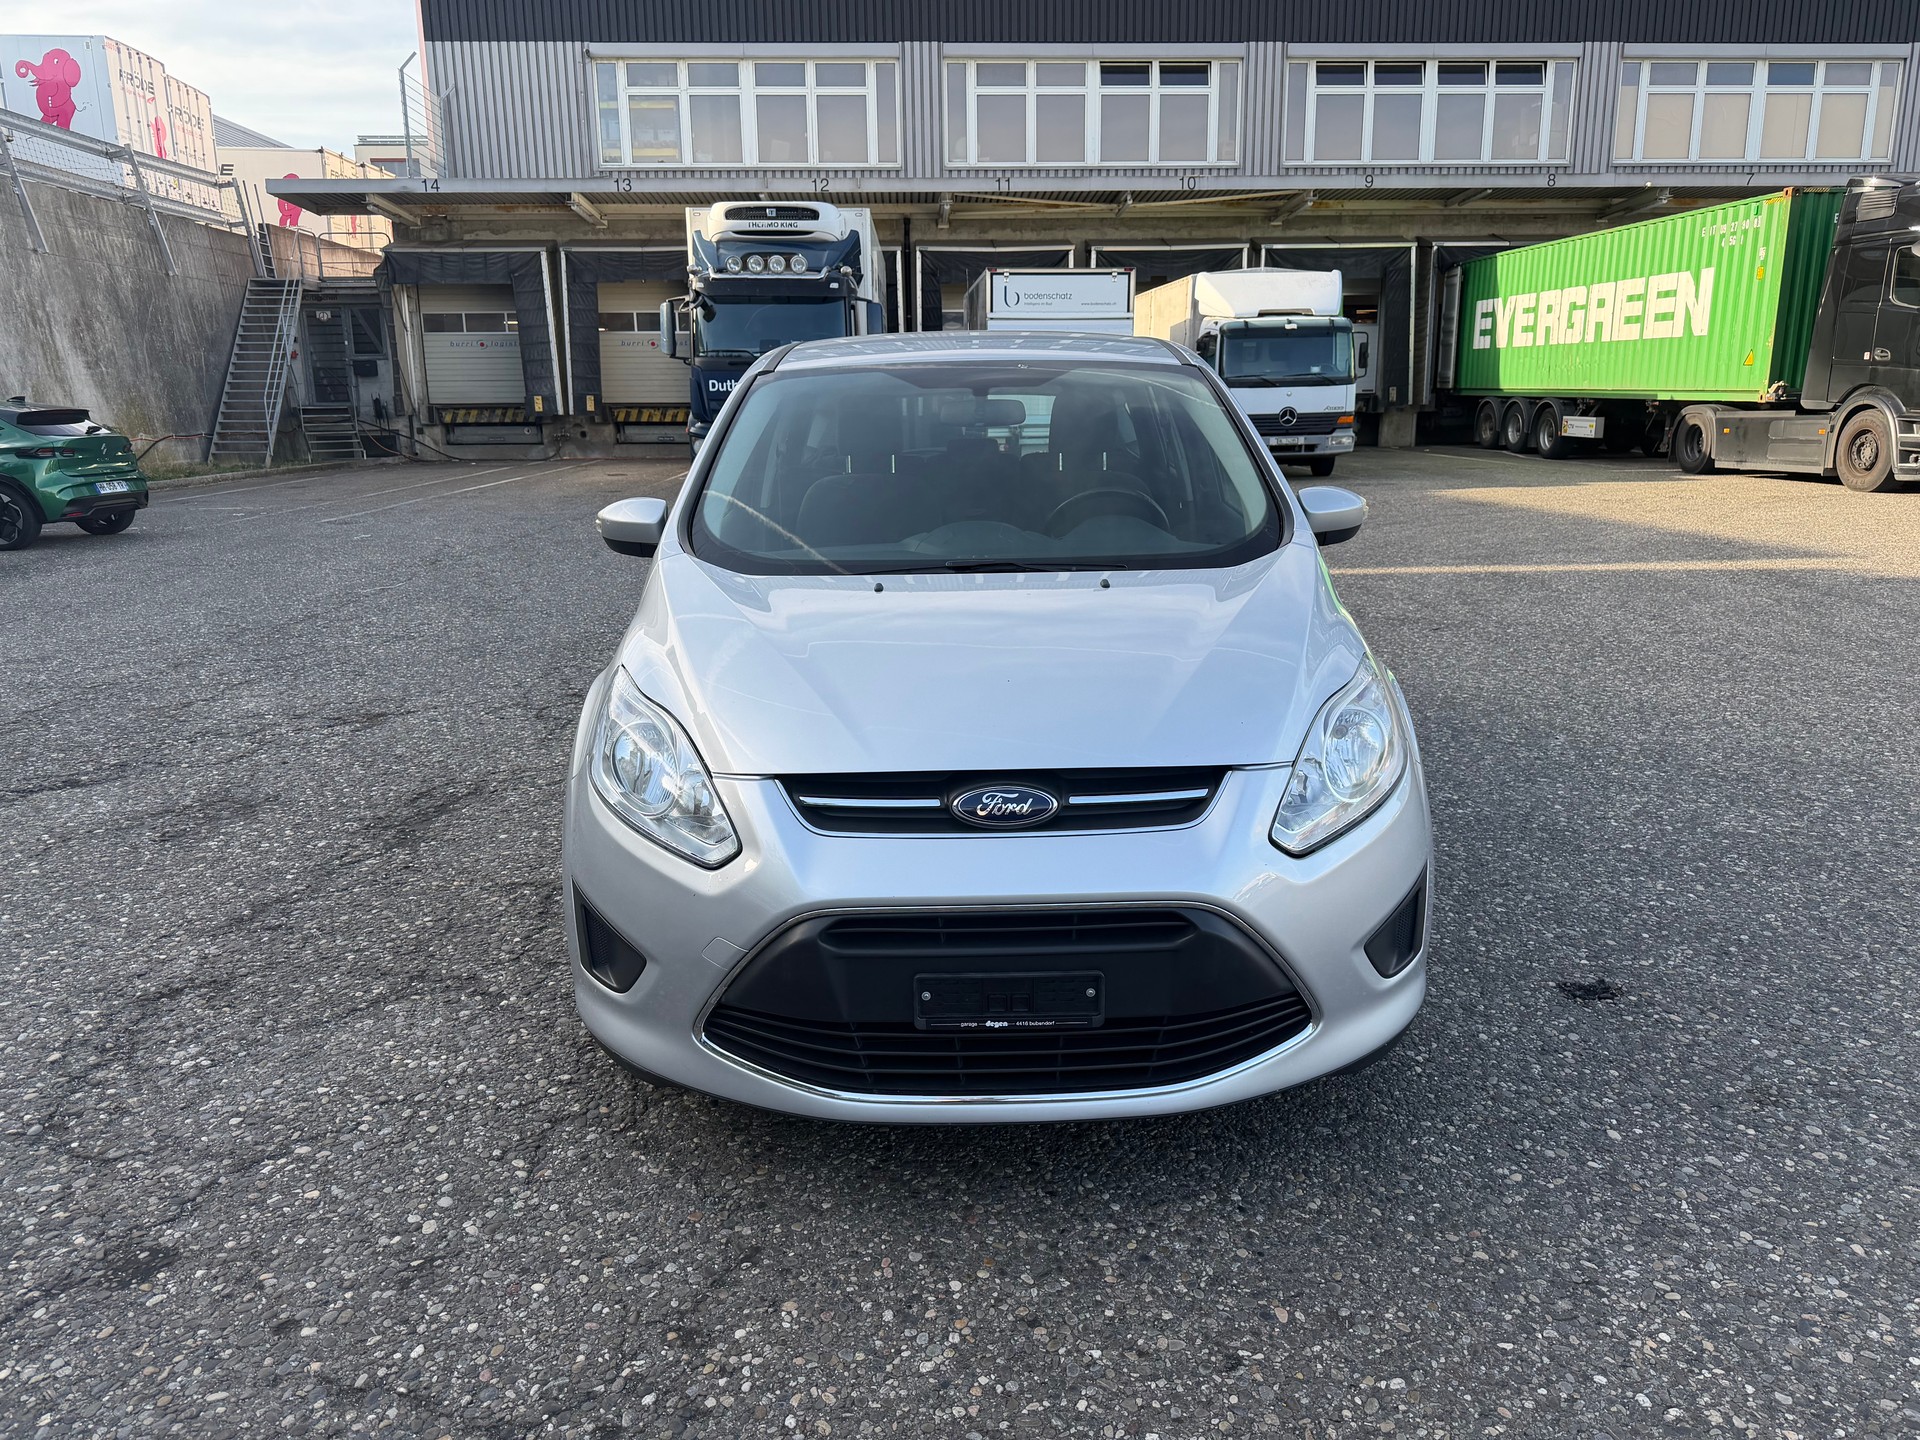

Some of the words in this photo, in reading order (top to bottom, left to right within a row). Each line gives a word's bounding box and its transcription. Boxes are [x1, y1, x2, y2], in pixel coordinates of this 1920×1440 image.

[421, 178, 440, 192] 14
[613, 177, 632, 192] 13
[811, 178, 830, 191] 12
[995, 178, 1010, 191] 11
[1179, 176, 1196, 190] 10
[1364, 174, 1374, 188] 9
[1547, 173, 1556, 187] 8
[1746, 172, 1755, 185] 7
[1023, 292, 1073, 300] bodenschatz
[1472, 267, 1715, 350] EVERGREEN
[976, 792, 1033, 816] Ford
[985, 1020, 1008, 1028] degen
